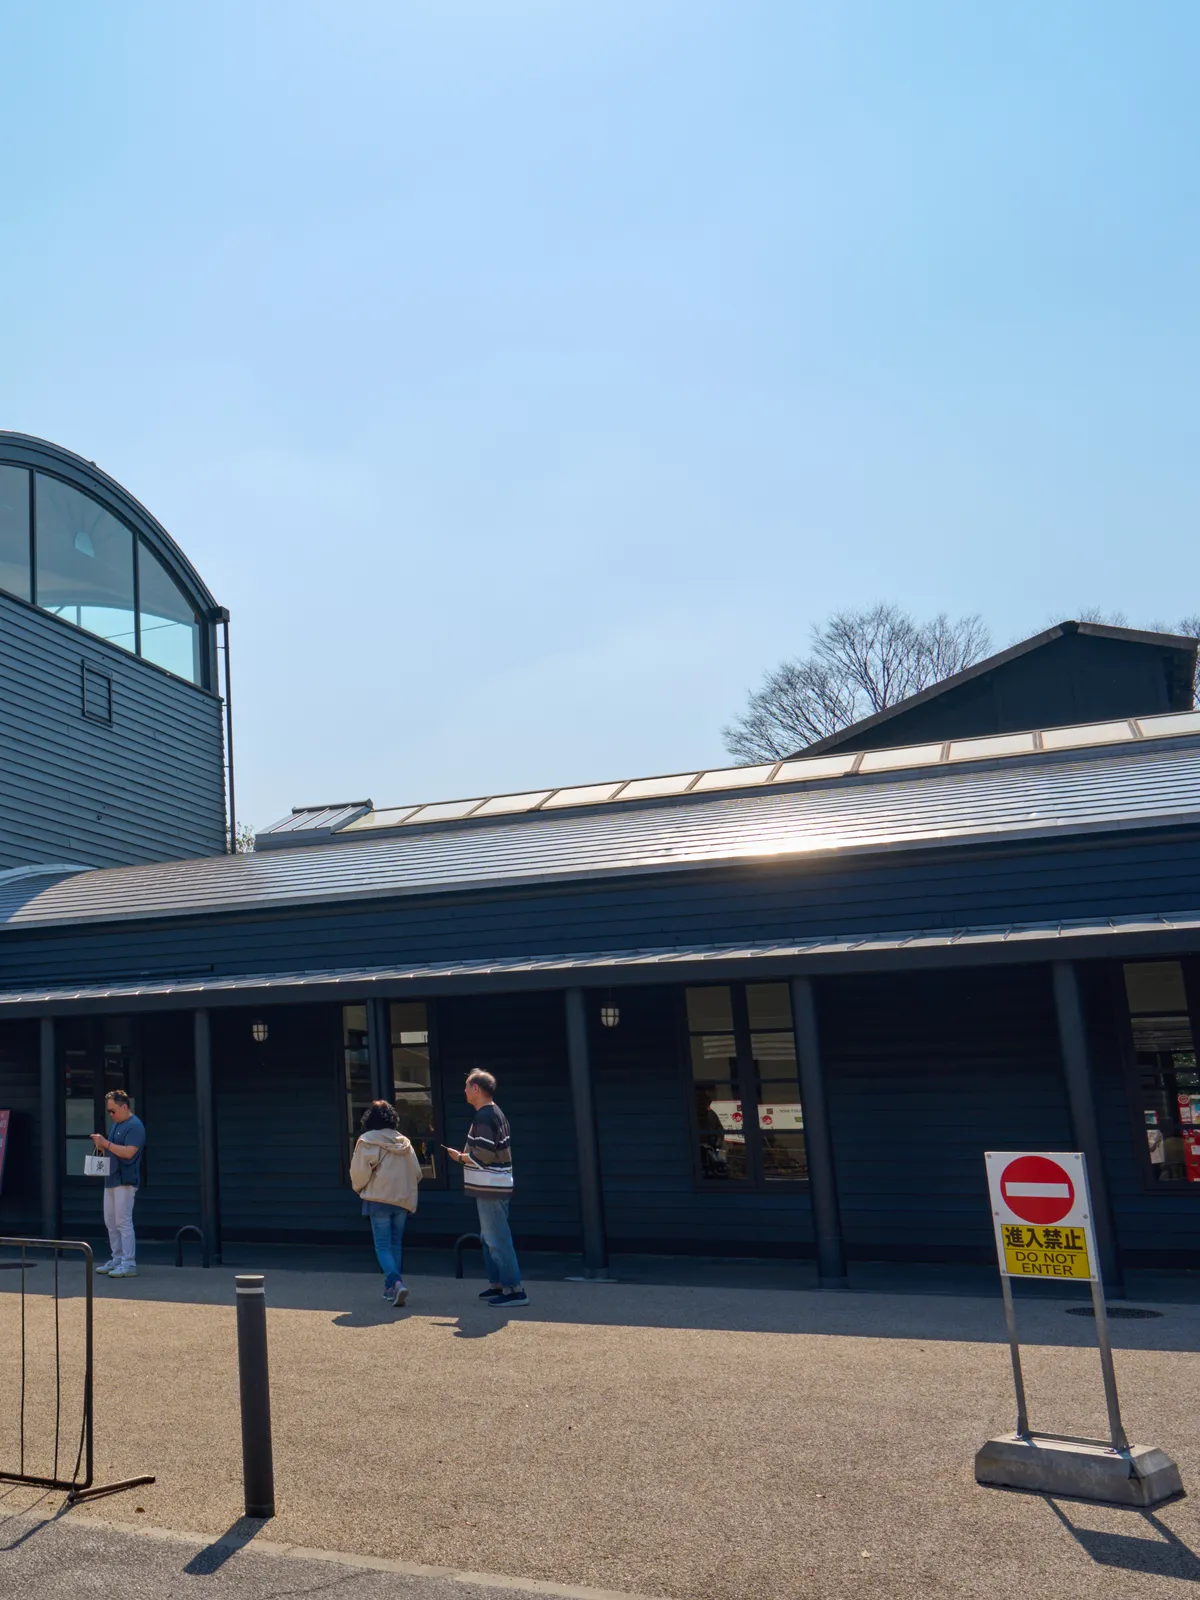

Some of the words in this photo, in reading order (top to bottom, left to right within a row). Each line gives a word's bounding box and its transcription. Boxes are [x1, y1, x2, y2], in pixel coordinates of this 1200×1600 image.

[1005, 1227, 1083, 1250] 進入禁止
[1015, 1251, 1038, 1262] DO
[1044, 1253, 1076, 1264] NOT
[1022, 1263, 1073, 1275] ENTER
